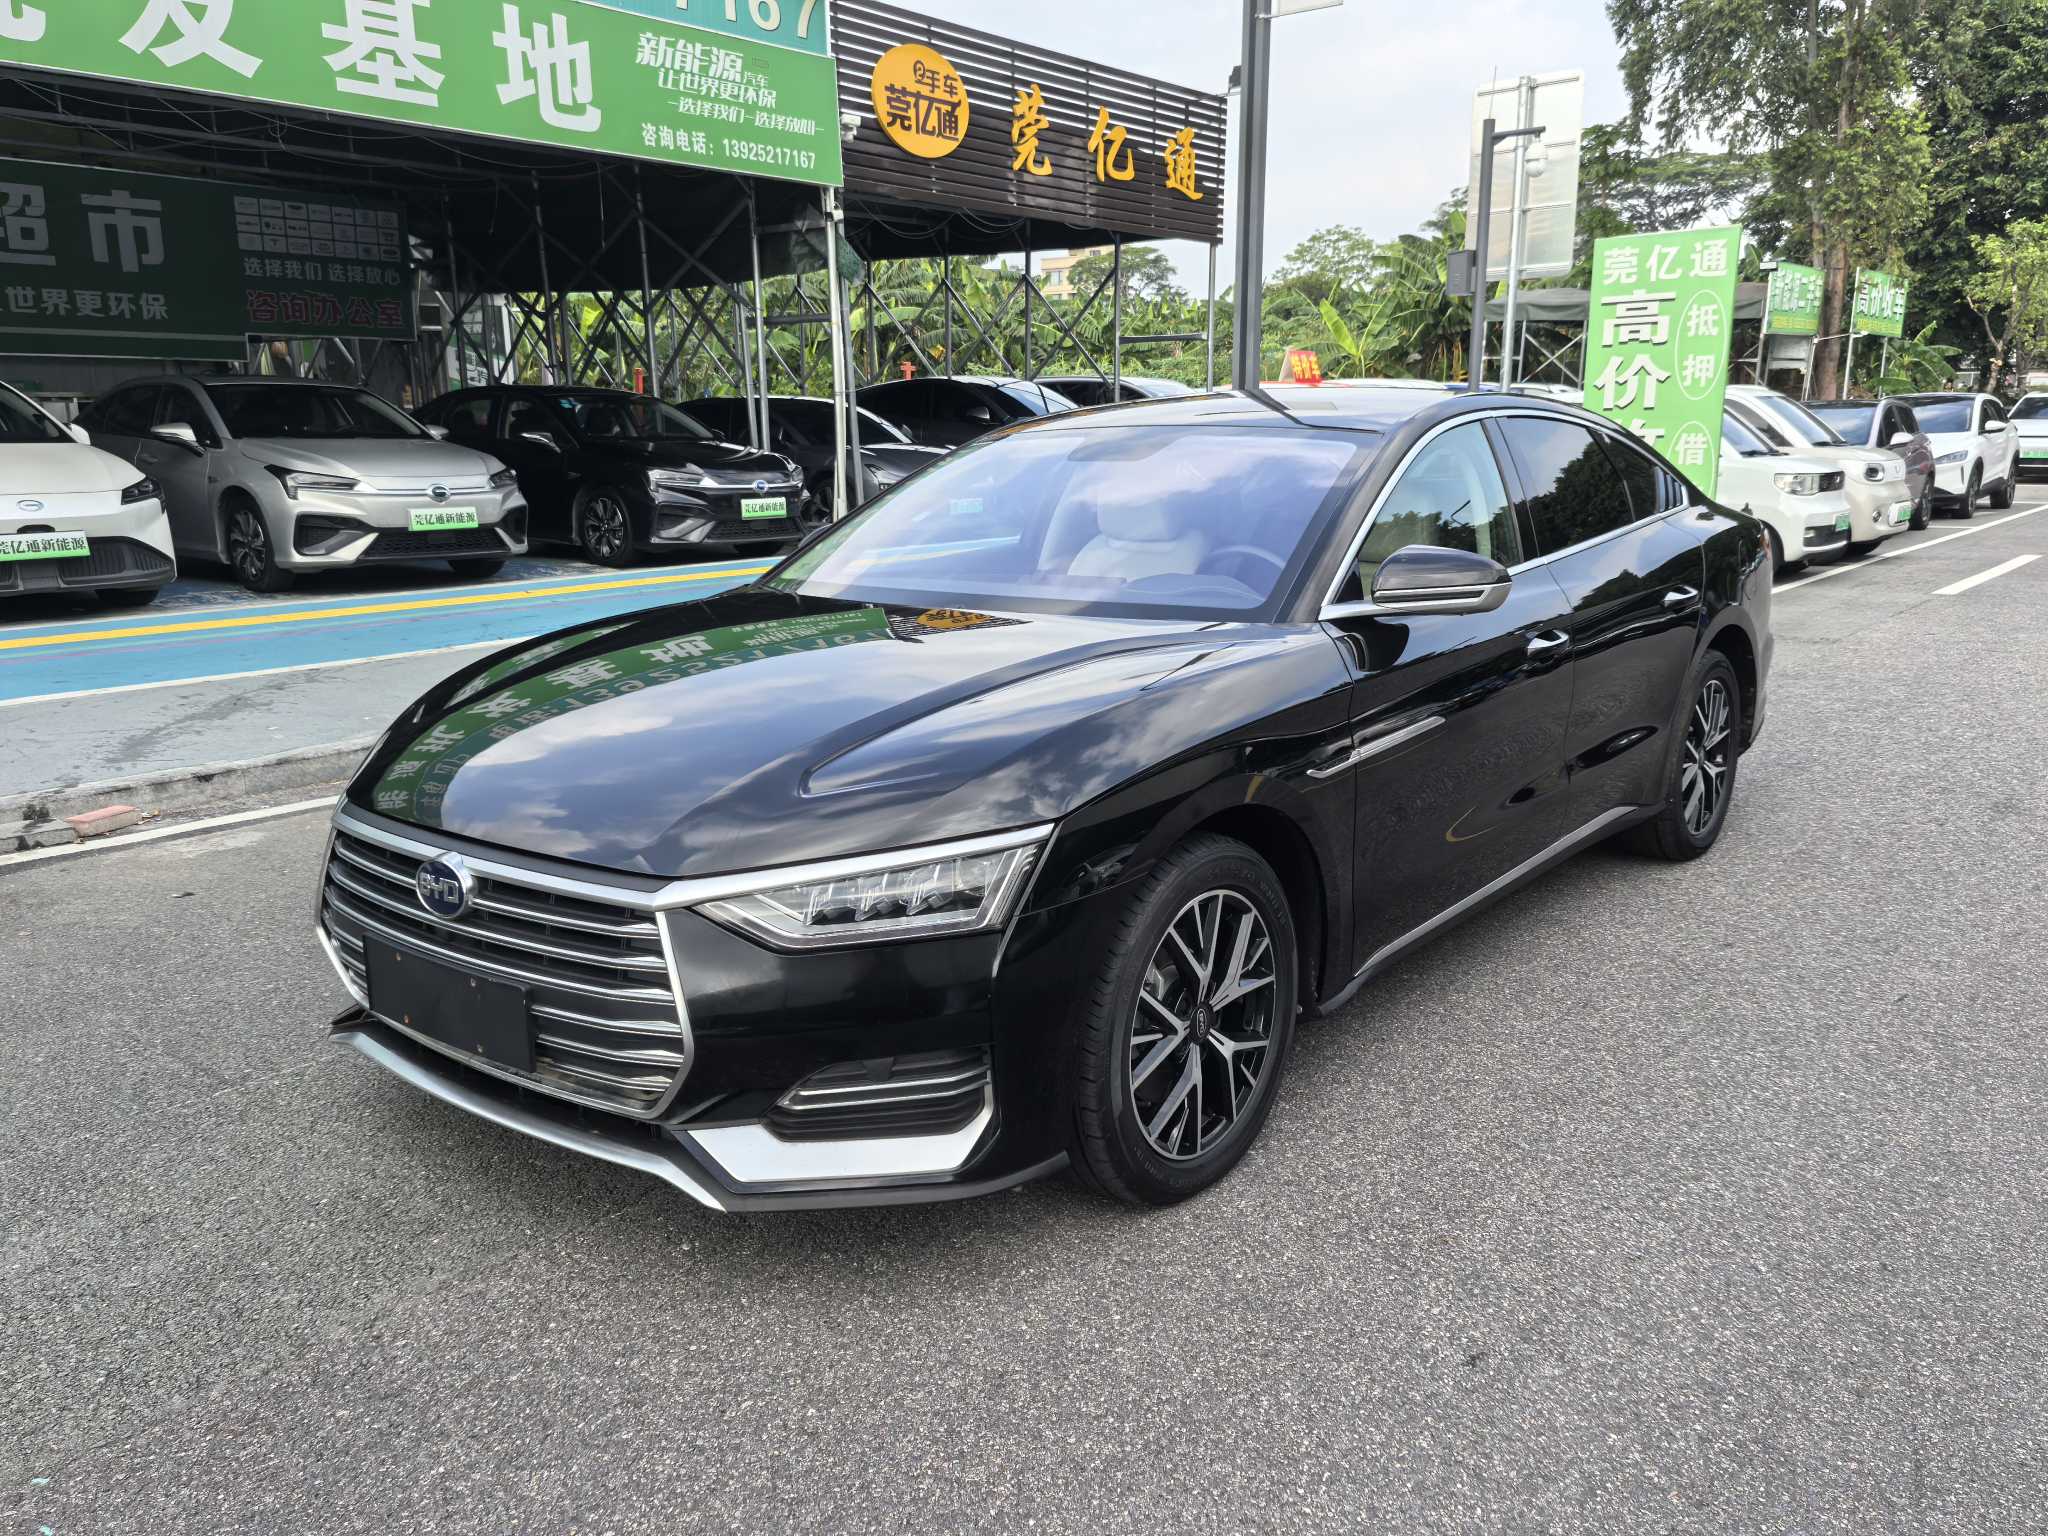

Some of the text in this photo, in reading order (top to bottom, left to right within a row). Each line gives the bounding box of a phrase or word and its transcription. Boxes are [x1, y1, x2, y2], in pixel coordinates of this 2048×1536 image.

[636, 32, 744, 82] 新能源
[658, 68, 777, 108] 让世界更环保
[743, 71, 769, 88] 汽车
[884, 83, 961, 141] 莞亿通
[722, 138, 817, 169] 13925217167
[1010, 84, 1203, 200] 莞亿通
[243, 257, 401, 286] 选择我们 选择放心
[1602, 239, 1729, 285] 莞亿通
[4, 286, 169, 320] 世界更环保
[246, 289, 401, 328] 咨询办公室
[1682, 304, 1719, 388] 抵押
[1676, 432, 1708, 466] 借
[415, 511, 475, 526] 莞亿通新能源
